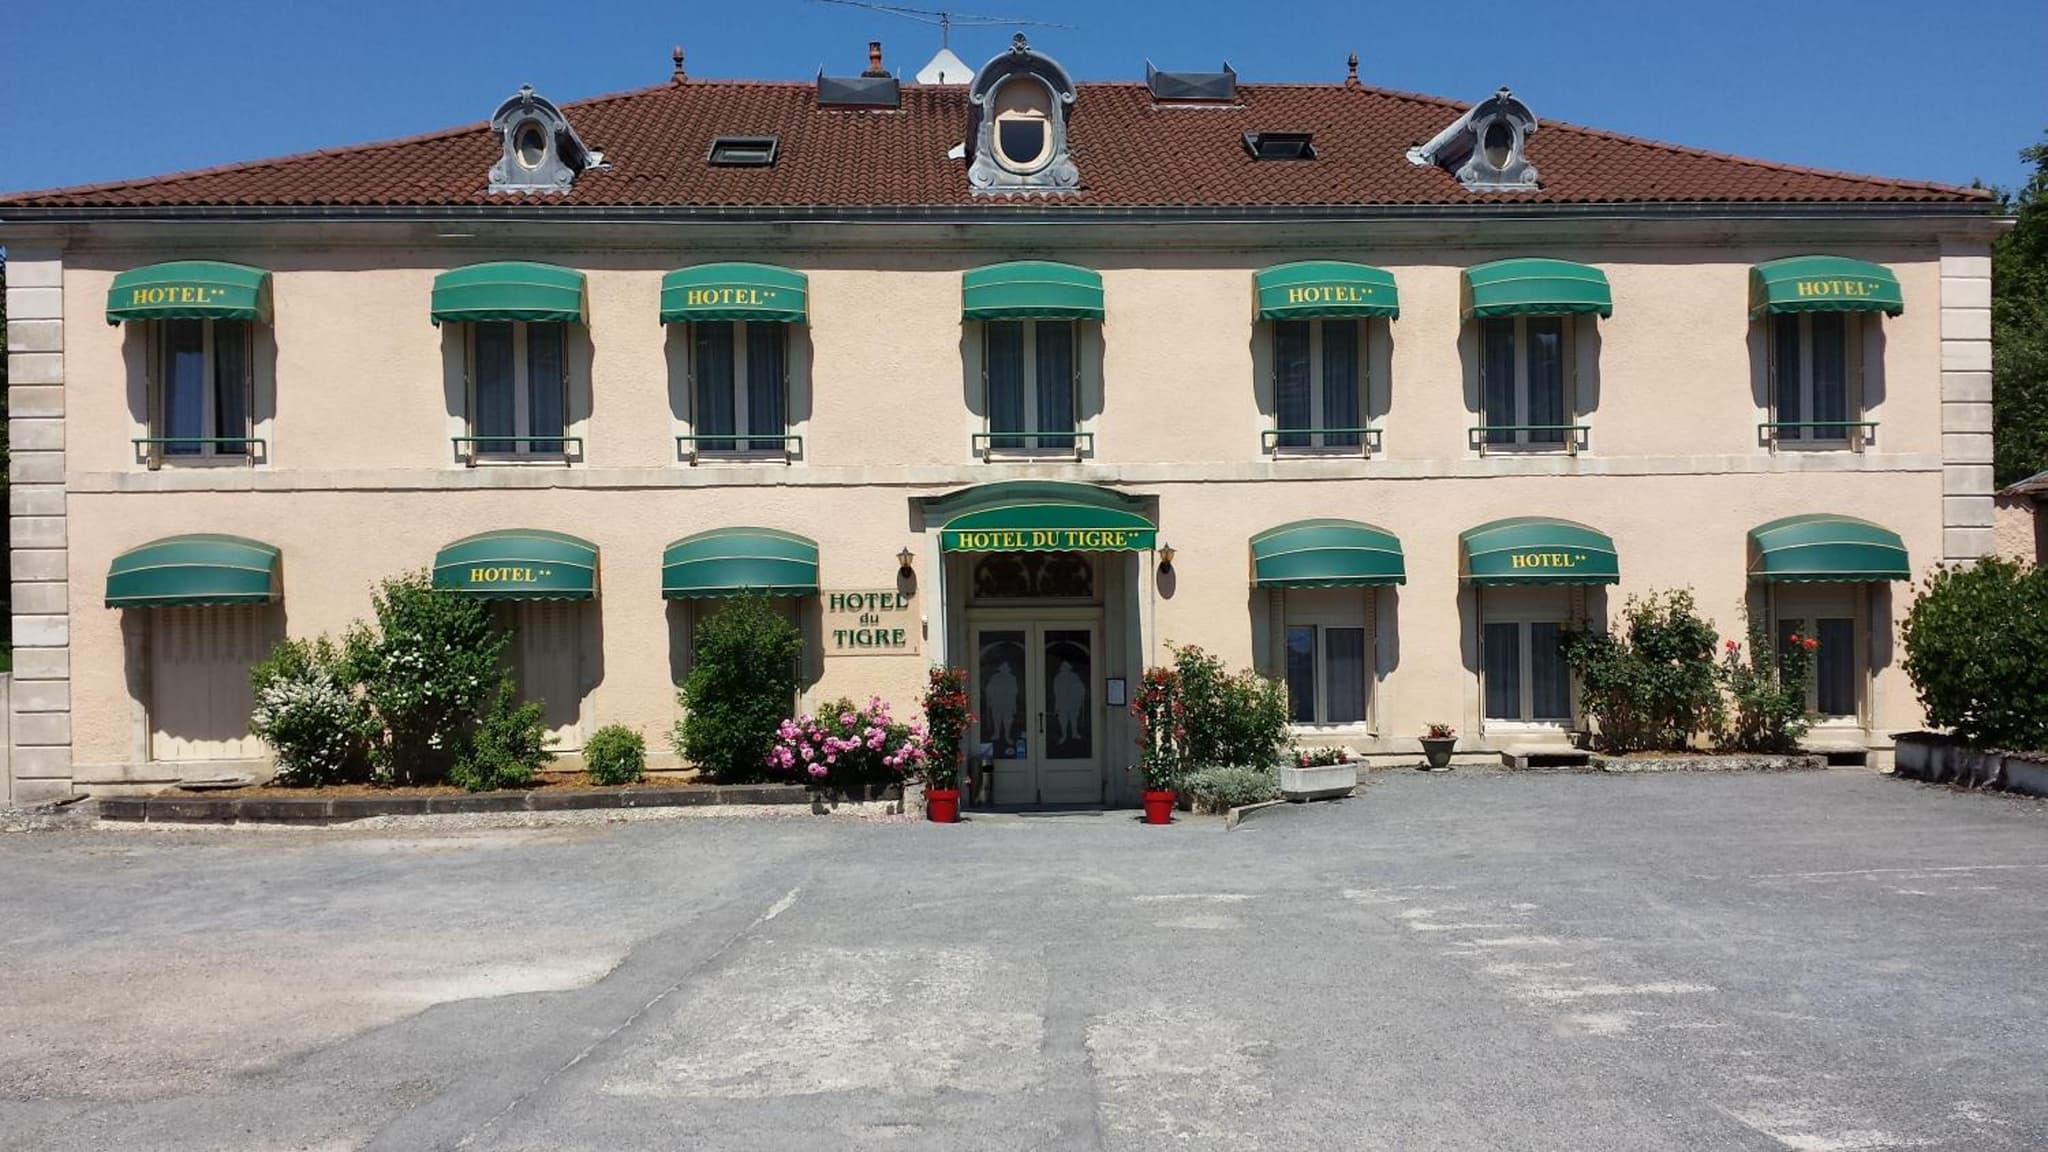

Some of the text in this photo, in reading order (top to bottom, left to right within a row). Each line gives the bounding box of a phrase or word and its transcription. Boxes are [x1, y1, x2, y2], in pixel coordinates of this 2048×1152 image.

[958, 532, 1028, 548] HOTEL
[1032, 531, 1060, 546] DU
[829, 592, 909, 610] HOTEL
[859, 612, 879, 625] du
[833, 628, 906, 646] TIGRE
